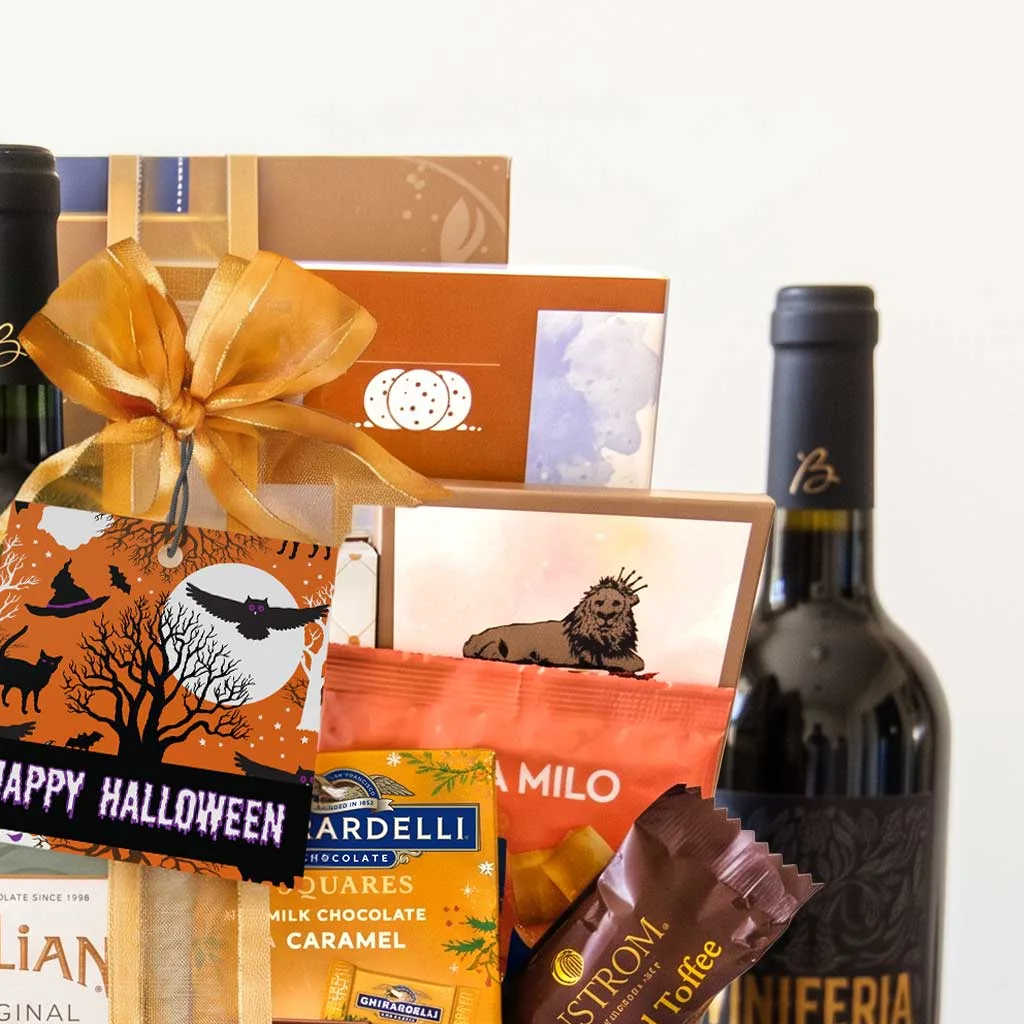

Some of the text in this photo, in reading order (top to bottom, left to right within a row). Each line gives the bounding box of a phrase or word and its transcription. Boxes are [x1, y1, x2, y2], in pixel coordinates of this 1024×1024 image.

[518, 761, 621, 803] MILO
[98, 775, 289, 848] HALLOWEEN
[307, 816, 465, 840] ARDELLI
[305, 854, 389, 863] HOCOLATE
[32, 893, 63, 902] SINCE
[270, 907, 426, 921] MILK CHOCOLATE
[286, 931, 406, 949] CARAMEL
[653, 940, 722, 1016] Toffee
